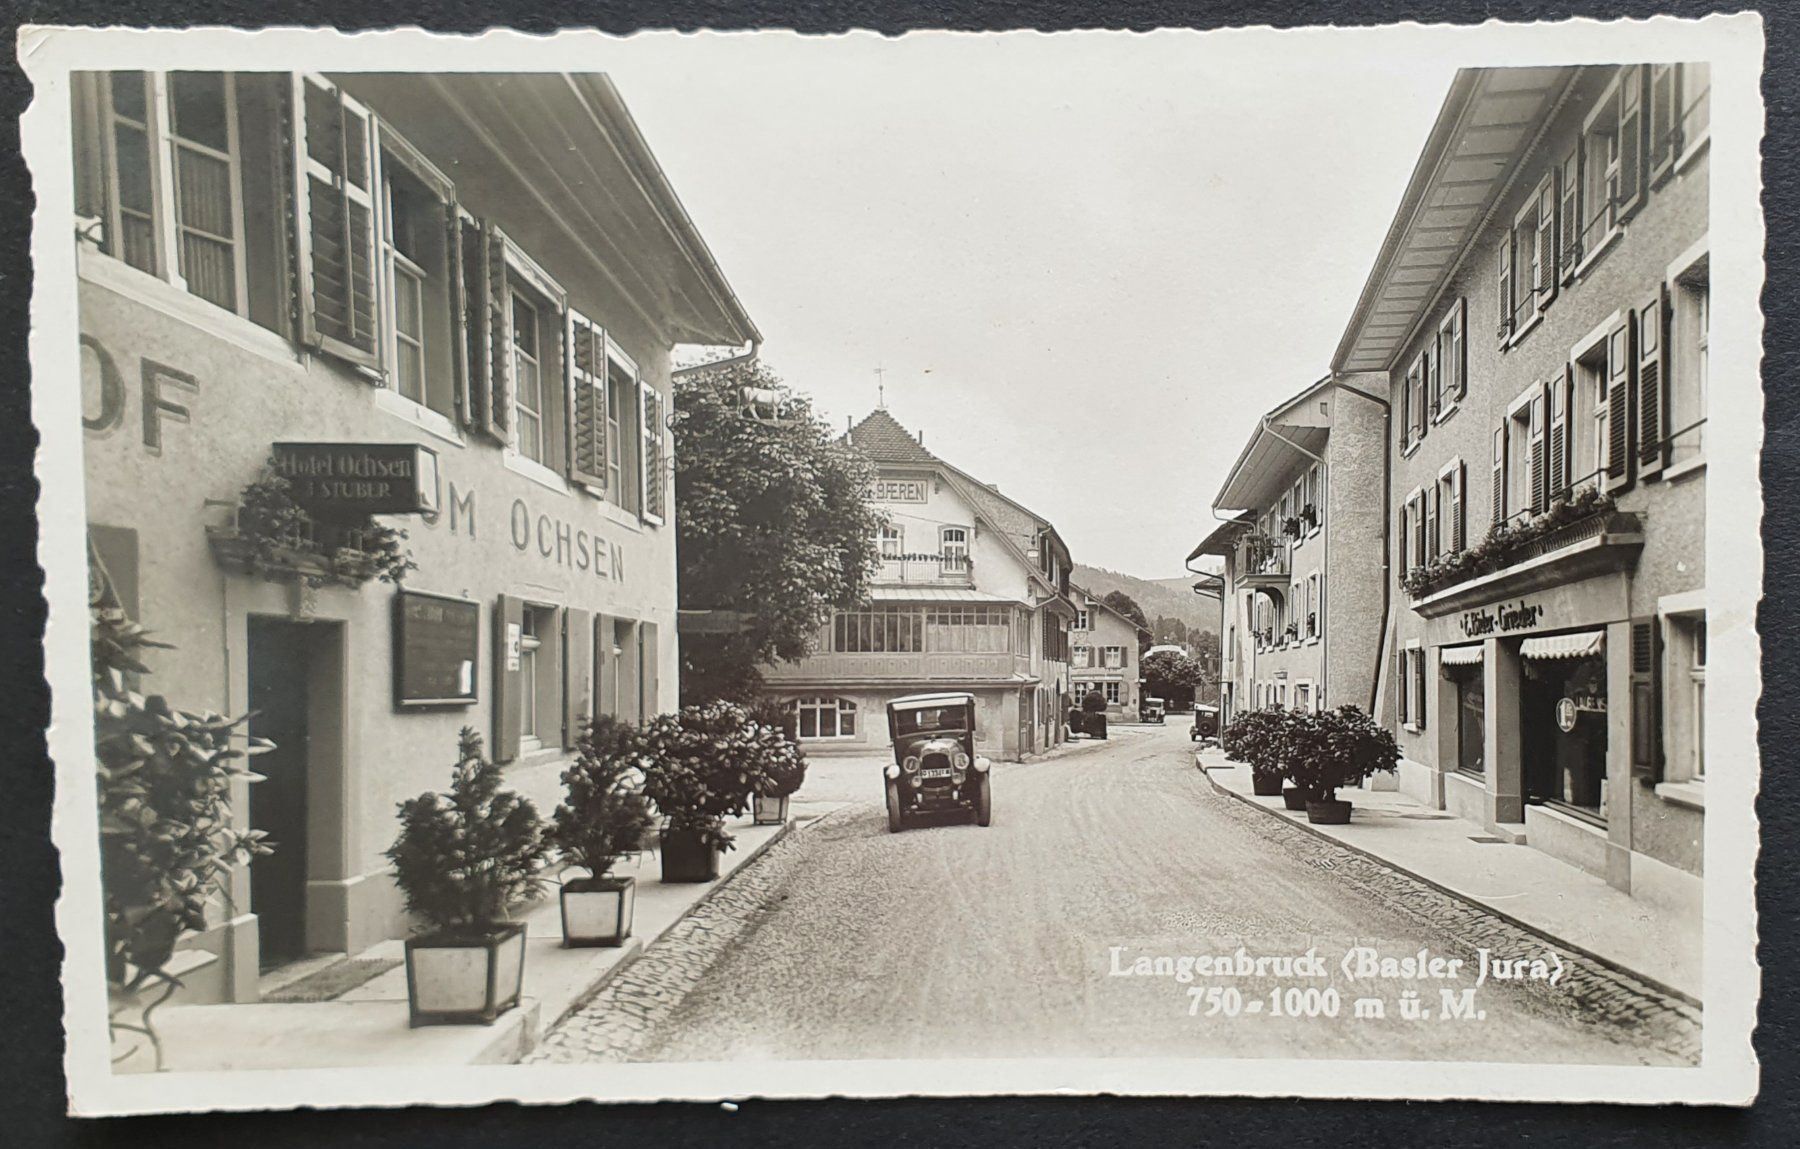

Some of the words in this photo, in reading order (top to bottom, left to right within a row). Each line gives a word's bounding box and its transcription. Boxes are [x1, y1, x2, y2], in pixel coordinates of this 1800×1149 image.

[278, 453, 334, 477] Hotel
[339, 453, 412, 478] Ochsen
[511, 498, 625, 583] OCHSEN
